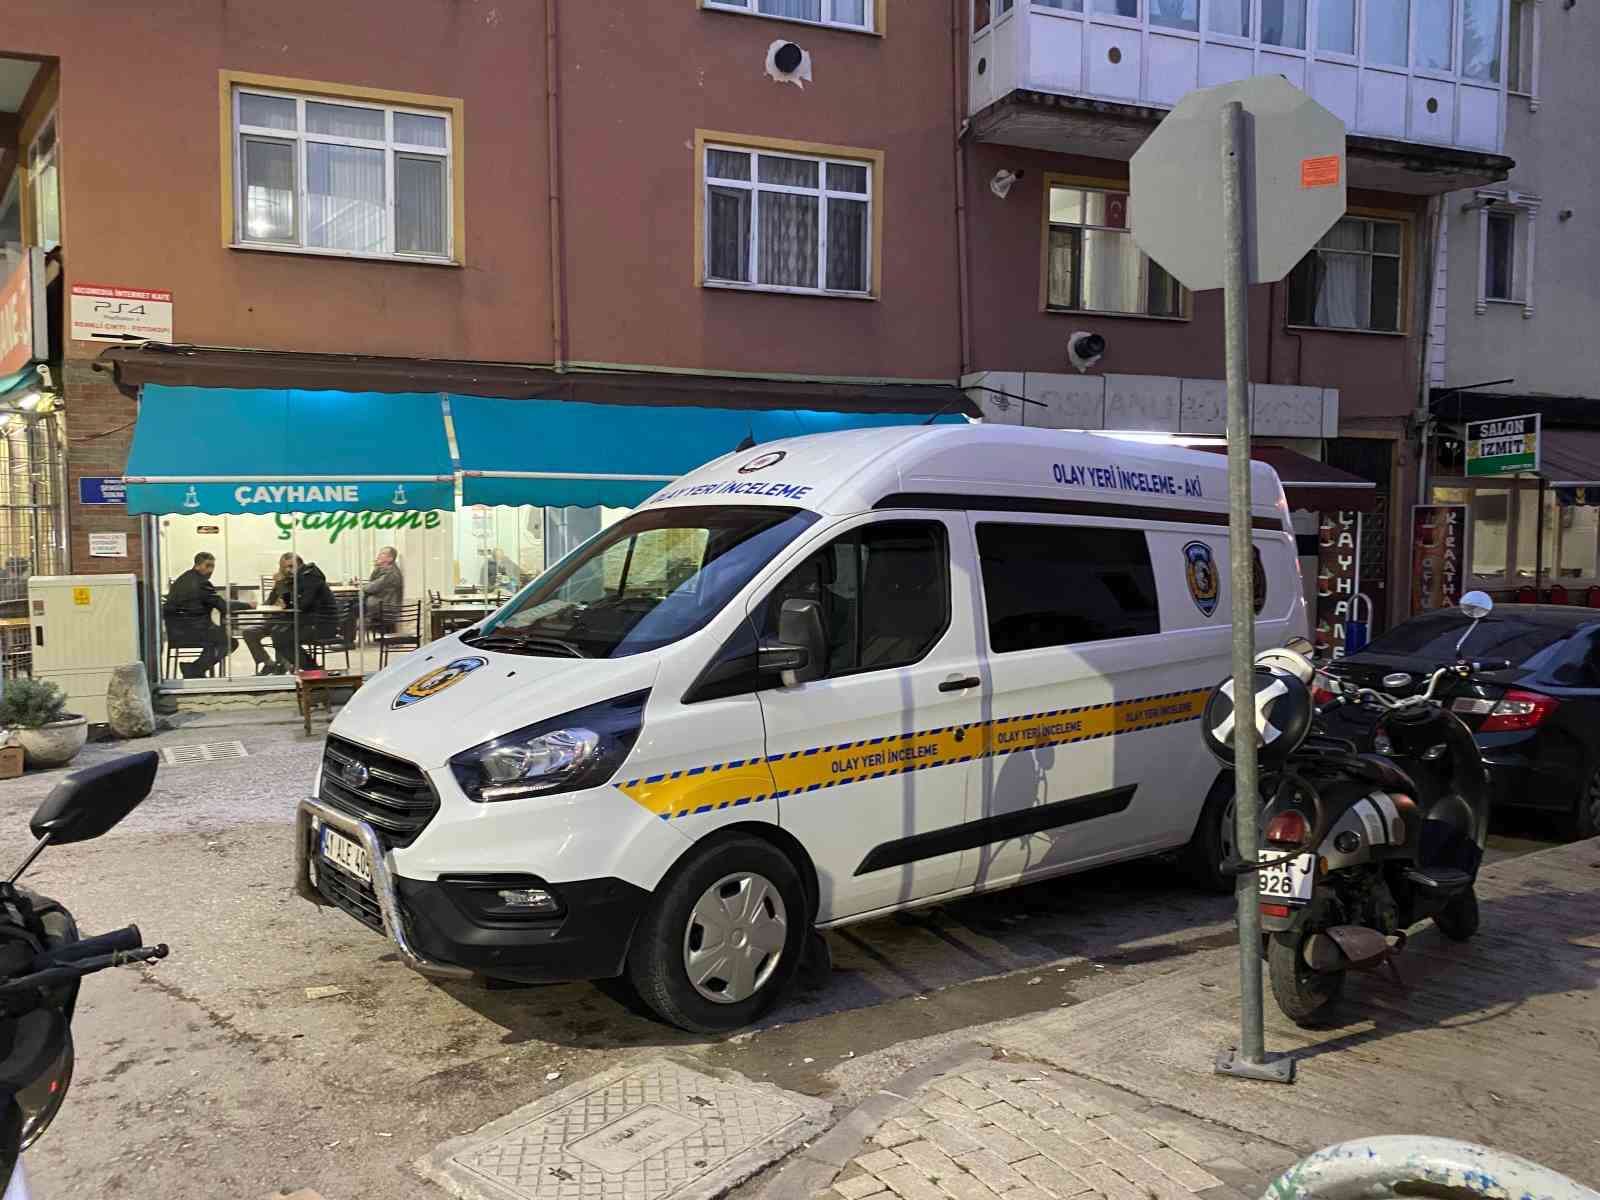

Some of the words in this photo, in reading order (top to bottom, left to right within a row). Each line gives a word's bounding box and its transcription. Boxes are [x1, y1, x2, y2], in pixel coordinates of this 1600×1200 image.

[94, 301, 146, 315] PS4
[1480, 420, 1525, 437] SALON
[1053, 463, 1085, 486] OLAY
[1086, 464, 1117, 489] YERİ
[1117, 466, 1176, 495] İNCELEME
[1185, 475, 1203, 497] AKİ
[234, 485, 360, 506] ÇAYHANE
[998, 729, 1021, 744] OLAY
[831, 757, 860, 774] OLAY
[861, 749, 886, 768] YERİ
[887, 743, 939, 764] İNCELEME
[1260, 874, 1293, 895] 926
